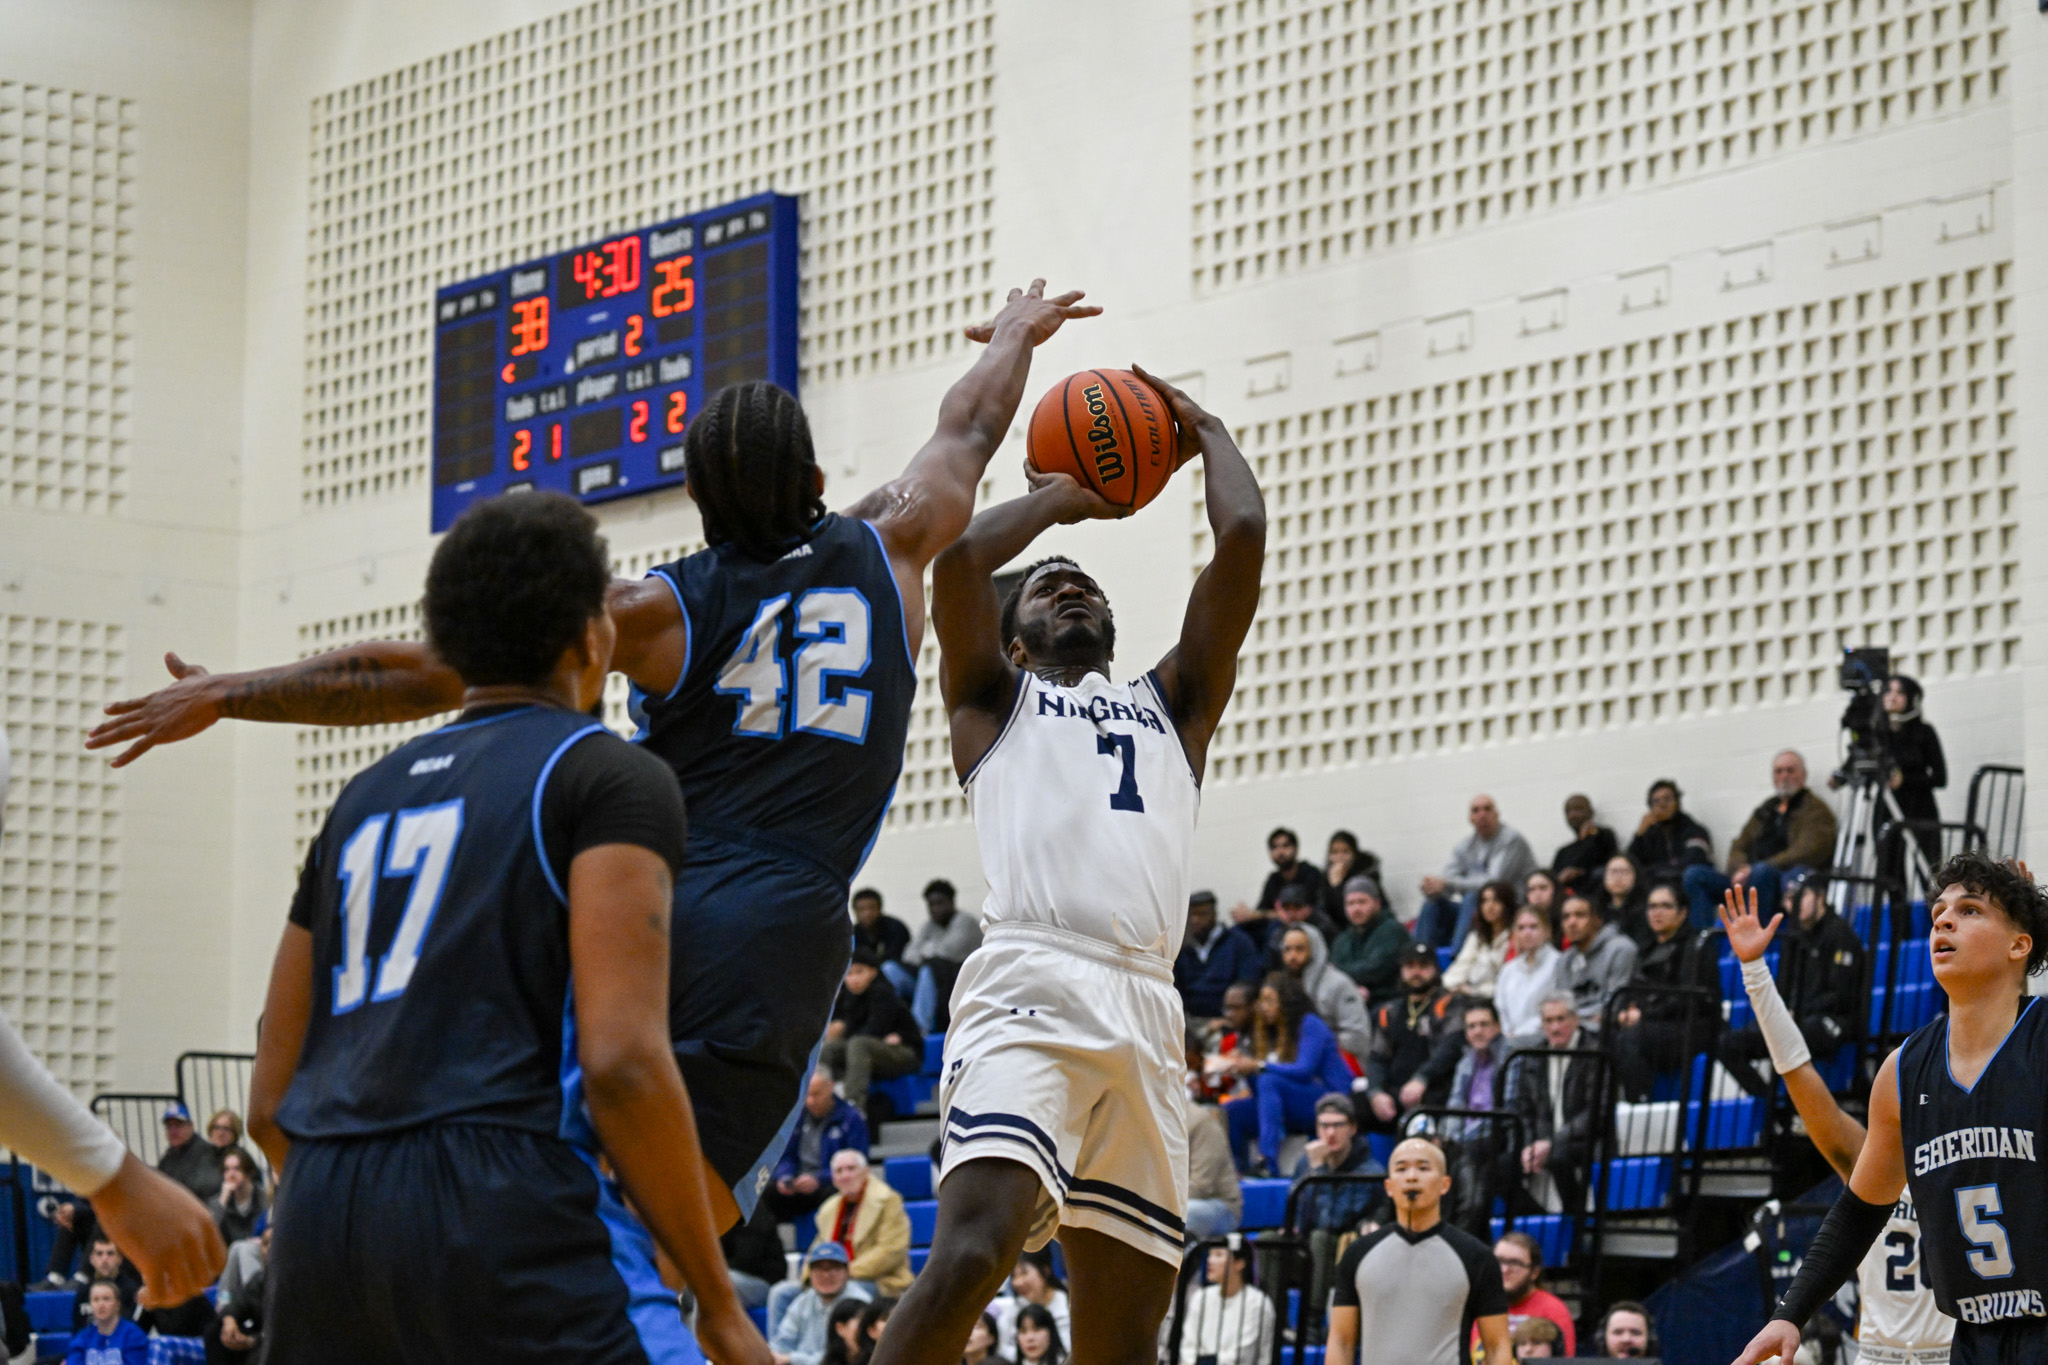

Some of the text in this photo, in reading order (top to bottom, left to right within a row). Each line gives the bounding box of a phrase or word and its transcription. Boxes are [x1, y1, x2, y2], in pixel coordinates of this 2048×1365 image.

[573, 236, 641, 299] 4:30
[652, 254, 694, 318] 25
[510, 296, 549, 356] 38
[624, 314, 643, 357] 2
[512, 429, 531, 471] 2
[630, 400, 649, 443] 2
[667, 390, 687, 434] 2
[1082, 383, 1126, 485] Wilson
[1122, 378, 1160, 467] EVOLUTION
[713, 586, 873, 745] 42
[1097, 732, 1145, 813] 7
[331, 797, 465, 1016] 17
[1914, 1126, 2037, 1177] SHERIDAN
[1954, 1183, 2016, 1280] 5
[1957, 1289, 2048, 1325] BRUINS
